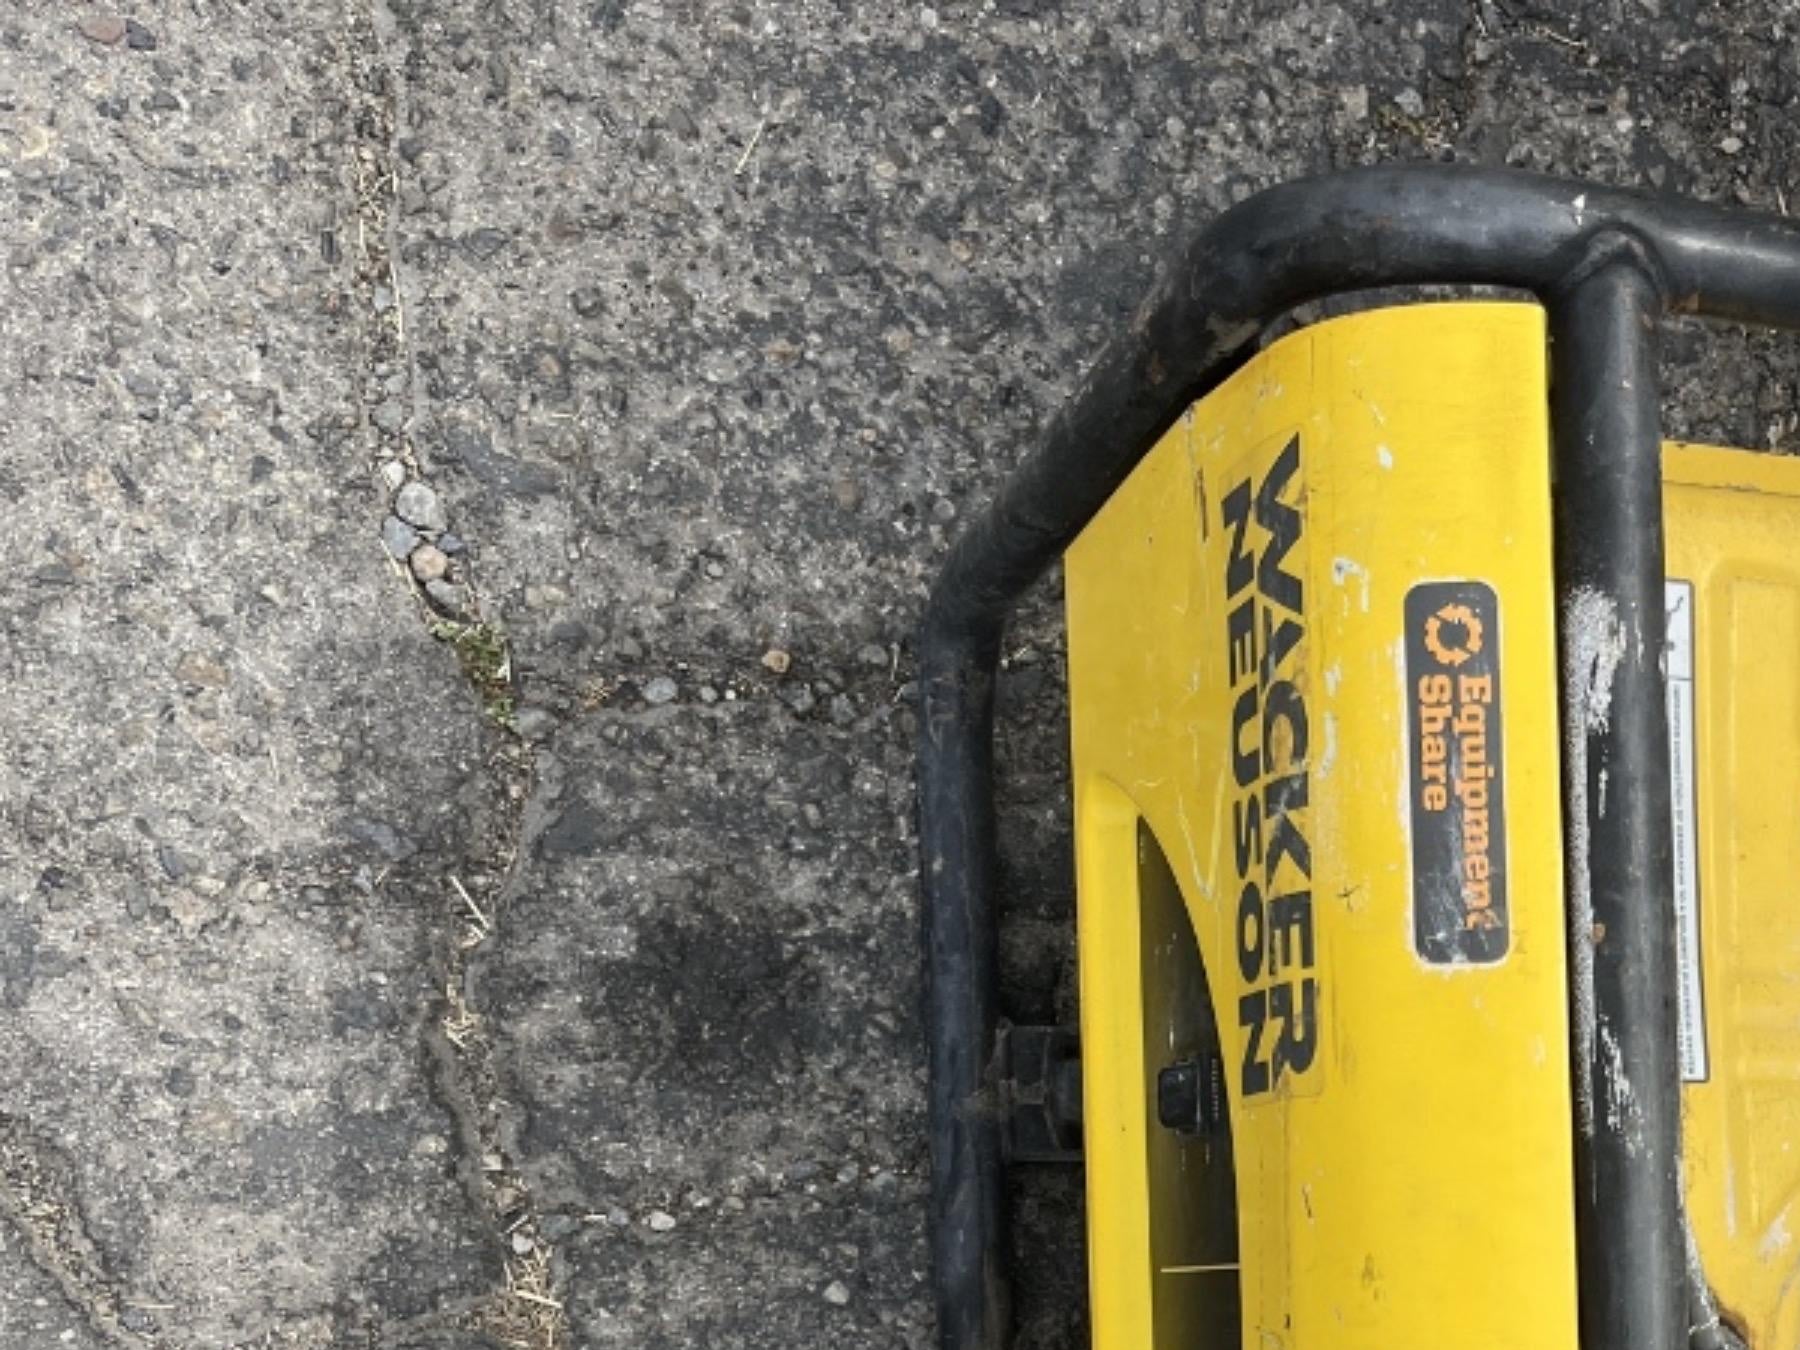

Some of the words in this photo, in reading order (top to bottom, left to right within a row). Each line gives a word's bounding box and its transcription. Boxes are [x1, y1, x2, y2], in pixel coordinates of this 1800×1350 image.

[1220, 476, 1270, 1099] NEUSON
[1255, 432, 1318, 1098] WACKER
[1418, 673, 1452, 811] Share
[1451, 674, 1497, 930] Equipment
